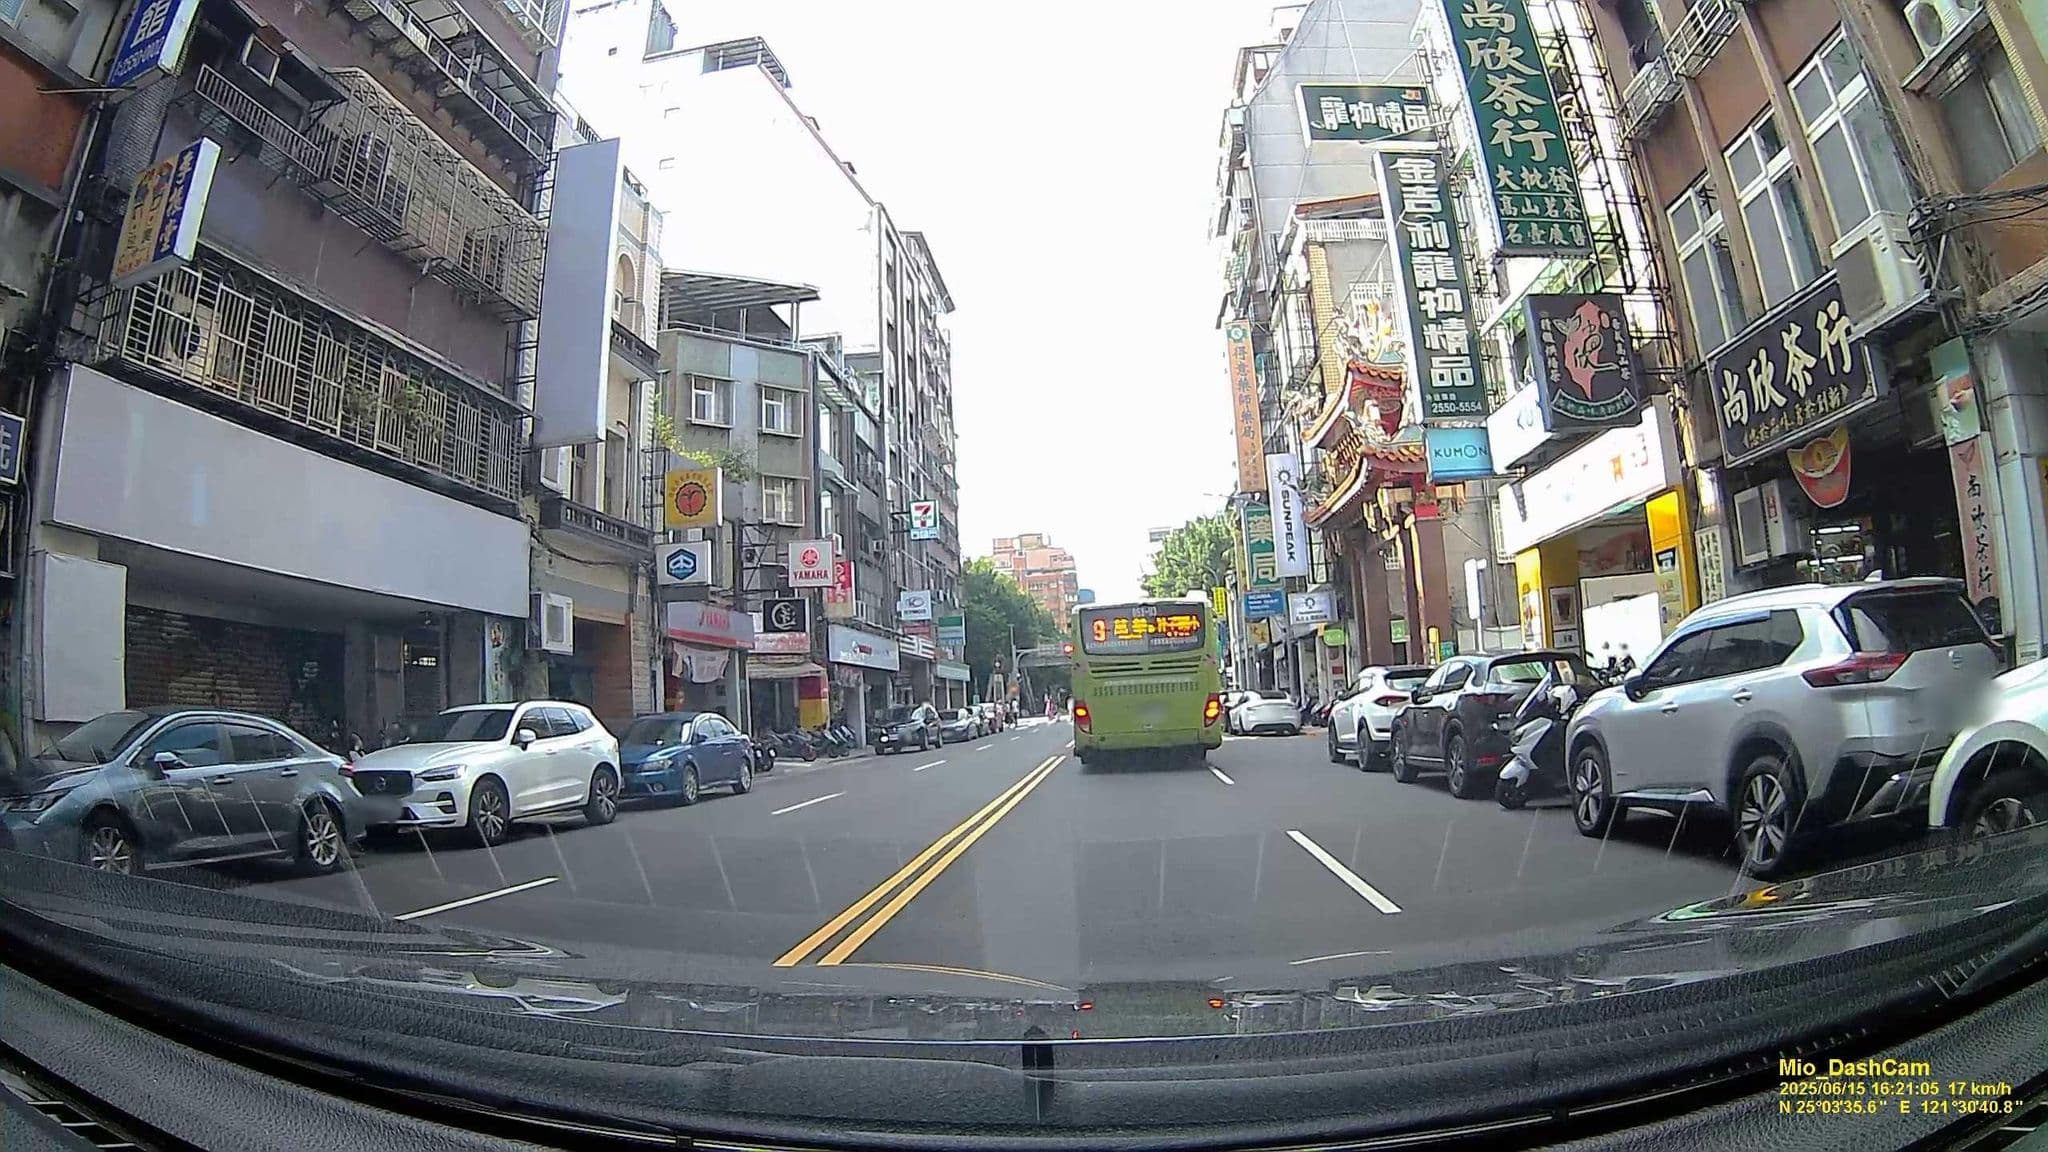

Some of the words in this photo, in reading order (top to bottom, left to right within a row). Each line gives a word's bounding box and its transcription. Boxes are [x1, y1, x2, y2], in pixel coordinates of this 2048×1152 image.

[1461, 0, 1557, 162] 尚欣茶行
[1496, 164, 1574, 194] 大批發
[1389, 157, 1475, 387] 金吉利寵物精品
[1721, 300, 1852, 429] 尚欣茶行
[1431, 401, 1482, 413] 2550-5554
[1434, 443, 1488, 459] KUMON
[1281, 489, 1297, 563] SUNPEAK
[793, 569, 830, 581] YAMAHA
